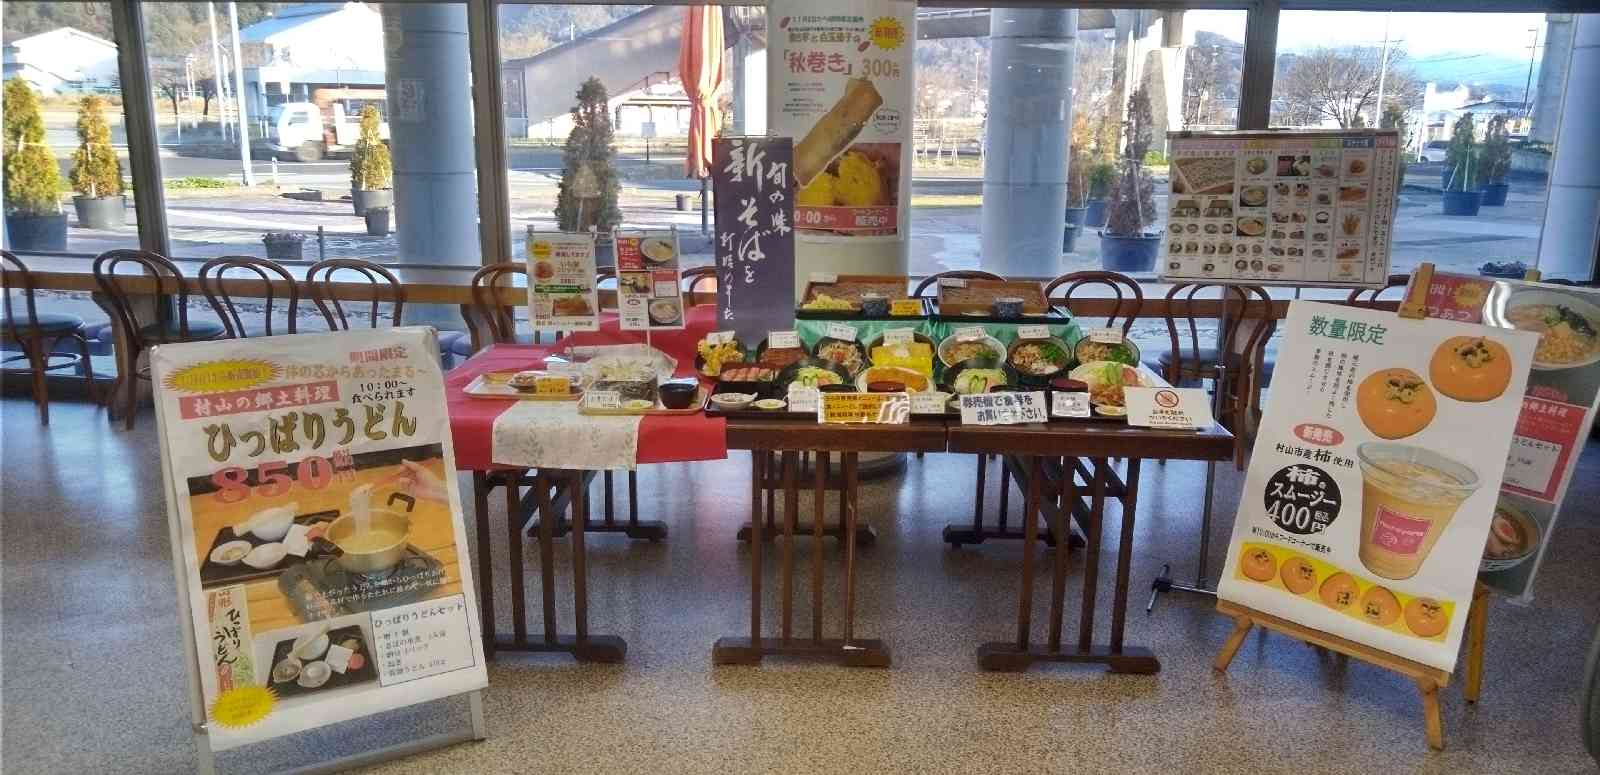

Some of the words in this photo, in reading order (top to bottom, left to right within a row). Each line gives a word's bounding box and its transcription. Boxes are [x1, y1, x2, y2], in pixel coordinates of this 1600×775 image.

[1309, 315, 1389, 346] 数量限定
[350, 344, 408, 364] 期間限定
[193, 384, 333, 417] 村山の郷土料理
[352, 387, 417, 404] 食べられます
[202, 400, 417, 462] ひっぱりうどん
[210, 454, 333, 503] 850
[1270, 482, 1337, 506] スムージー
[1264, 500, 1310, 529] 400
[375, 600, 464, 628] ひっぱりうどんセット
